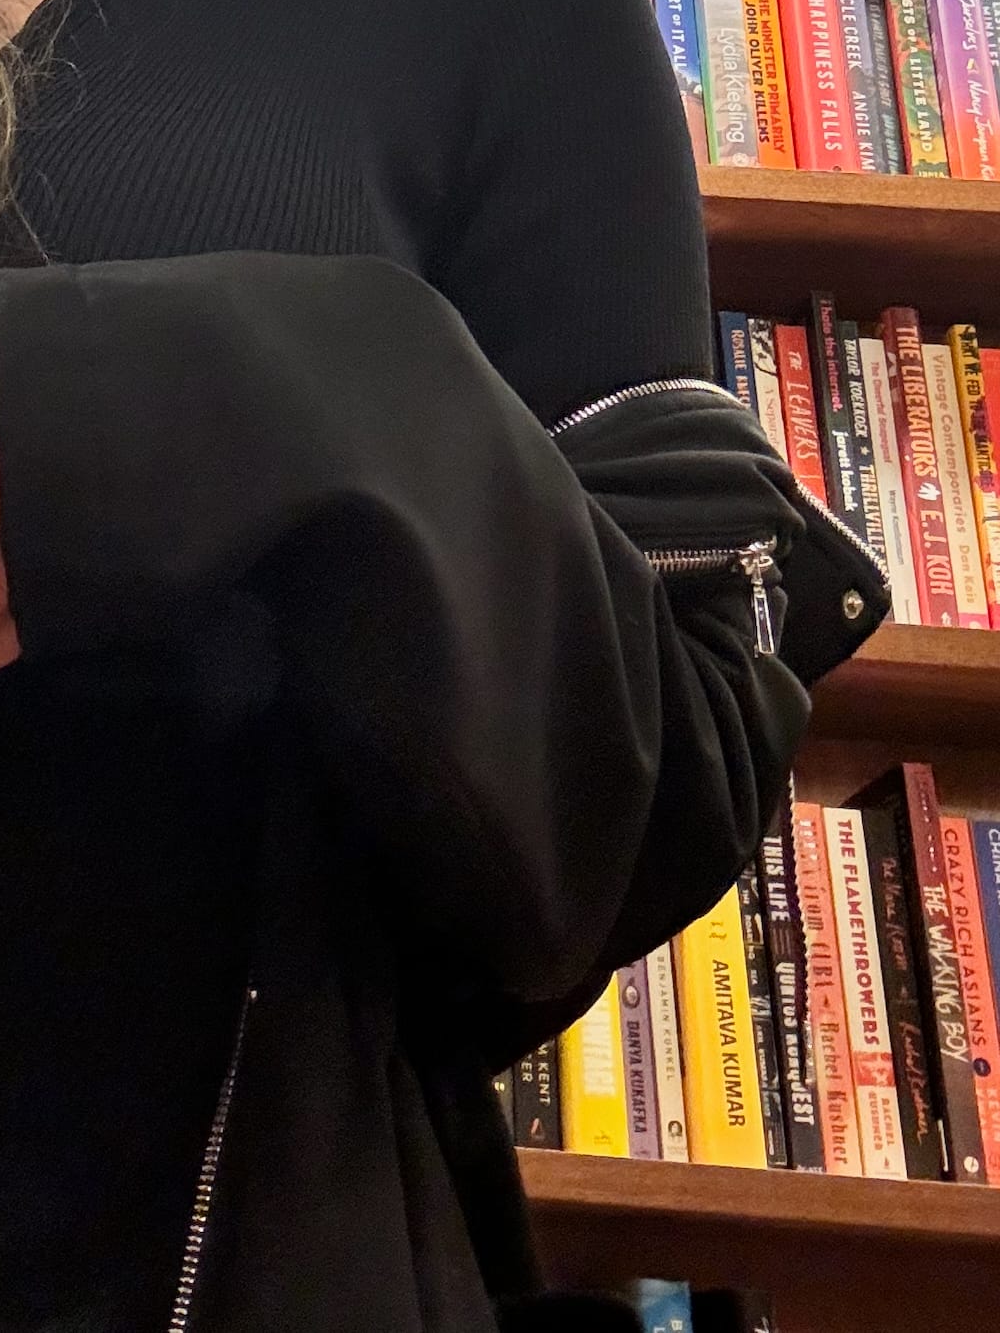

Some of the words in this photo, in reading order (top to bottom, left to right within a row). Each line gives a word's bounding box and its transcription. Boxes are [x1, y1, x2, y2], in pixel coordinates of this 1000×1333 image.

[671, 29, 685, 42] IT
[745, 0, 758, 35] JOHN
[673, 44, 689, 70] ALL
[717, 27, 740, 69] Lydia
[750, 38, 764, 87] OLIVER
[761, 20, 776, 79] MINISTER
[843, 26, 863, 70] CREEK
[909, 57, 927, 107] LITTLE
[724, 73, 749, 144] Kiesling
[754, 90, 769, 144] KILLENS
[766, 82, 785, 155] PRIMARILY
[820, 99, 843, 151] FALLS
[852, 90, 873, 136] ANGIE
[916, 110, 933, 153] LAND
[858, 141, 876, 171] KIM
[789, 351, 802, 371] THE
[843, 338, 860, 376] TAYLOR
[896, 326, 919, 359] THE
[931, 353, 950, 409] Vintage
[787, 380, 817, 459] LEAVERS
[850, 380, 869, 438] KOEKKOEK
[902, 364, 939, 477] LIBERATORS
[832, 430, 853, 468] jarett
[940, 413, 968, 533] Contemporaries
[842, 469, 859, 511] kobek
[860, 464, 885, 553] THRILLVILLE
[920, 509, 941, 527] E.
[924, 530, 946, 548] J.
[926, 553, 954, 595] KOH
[959, 544, 973, 571] Dan
[761, 835, 786, 876] THIS
[838, 818, 857, 859] THE
[943, 828, 968, 898] CRAZY
[767, 881, 791, 922] LIFE
[805, 883, 830, 932] from
[922, 882, 949, 916] THE
[841, 864, 881, 1045] FLAMETHROWERS
[954, 905, 974, 958] RICH
[656, 955, 671, 1022] BENJAMIN
[750, 969, 759, 985] SEA
[811, 941, 837, 989] CUBA
[928, 923, 959, 1013] WALKING
[961, 965, 987, 1047] ASIANS
[627, 1019, 642, 1065] DANYA
[662, 1027, 676, 1082] KUNKEL
[711, 958, 734, 1047] AMITAVA
[723, 1051, 747, 1127] KUMAR
[817, 1021, 845, 1081] Rachel
[941, 1020, 969, 1064] BOY
[537, 1061, 551, 1104] KENT
[630, 1068, 648, 1134] KUKAFKA
[827, 1089, 852, 1166] Kushner
[868, 1089, 884, 1152] KUSHNER
[880, 1096, 896, 1147] RACHEL
